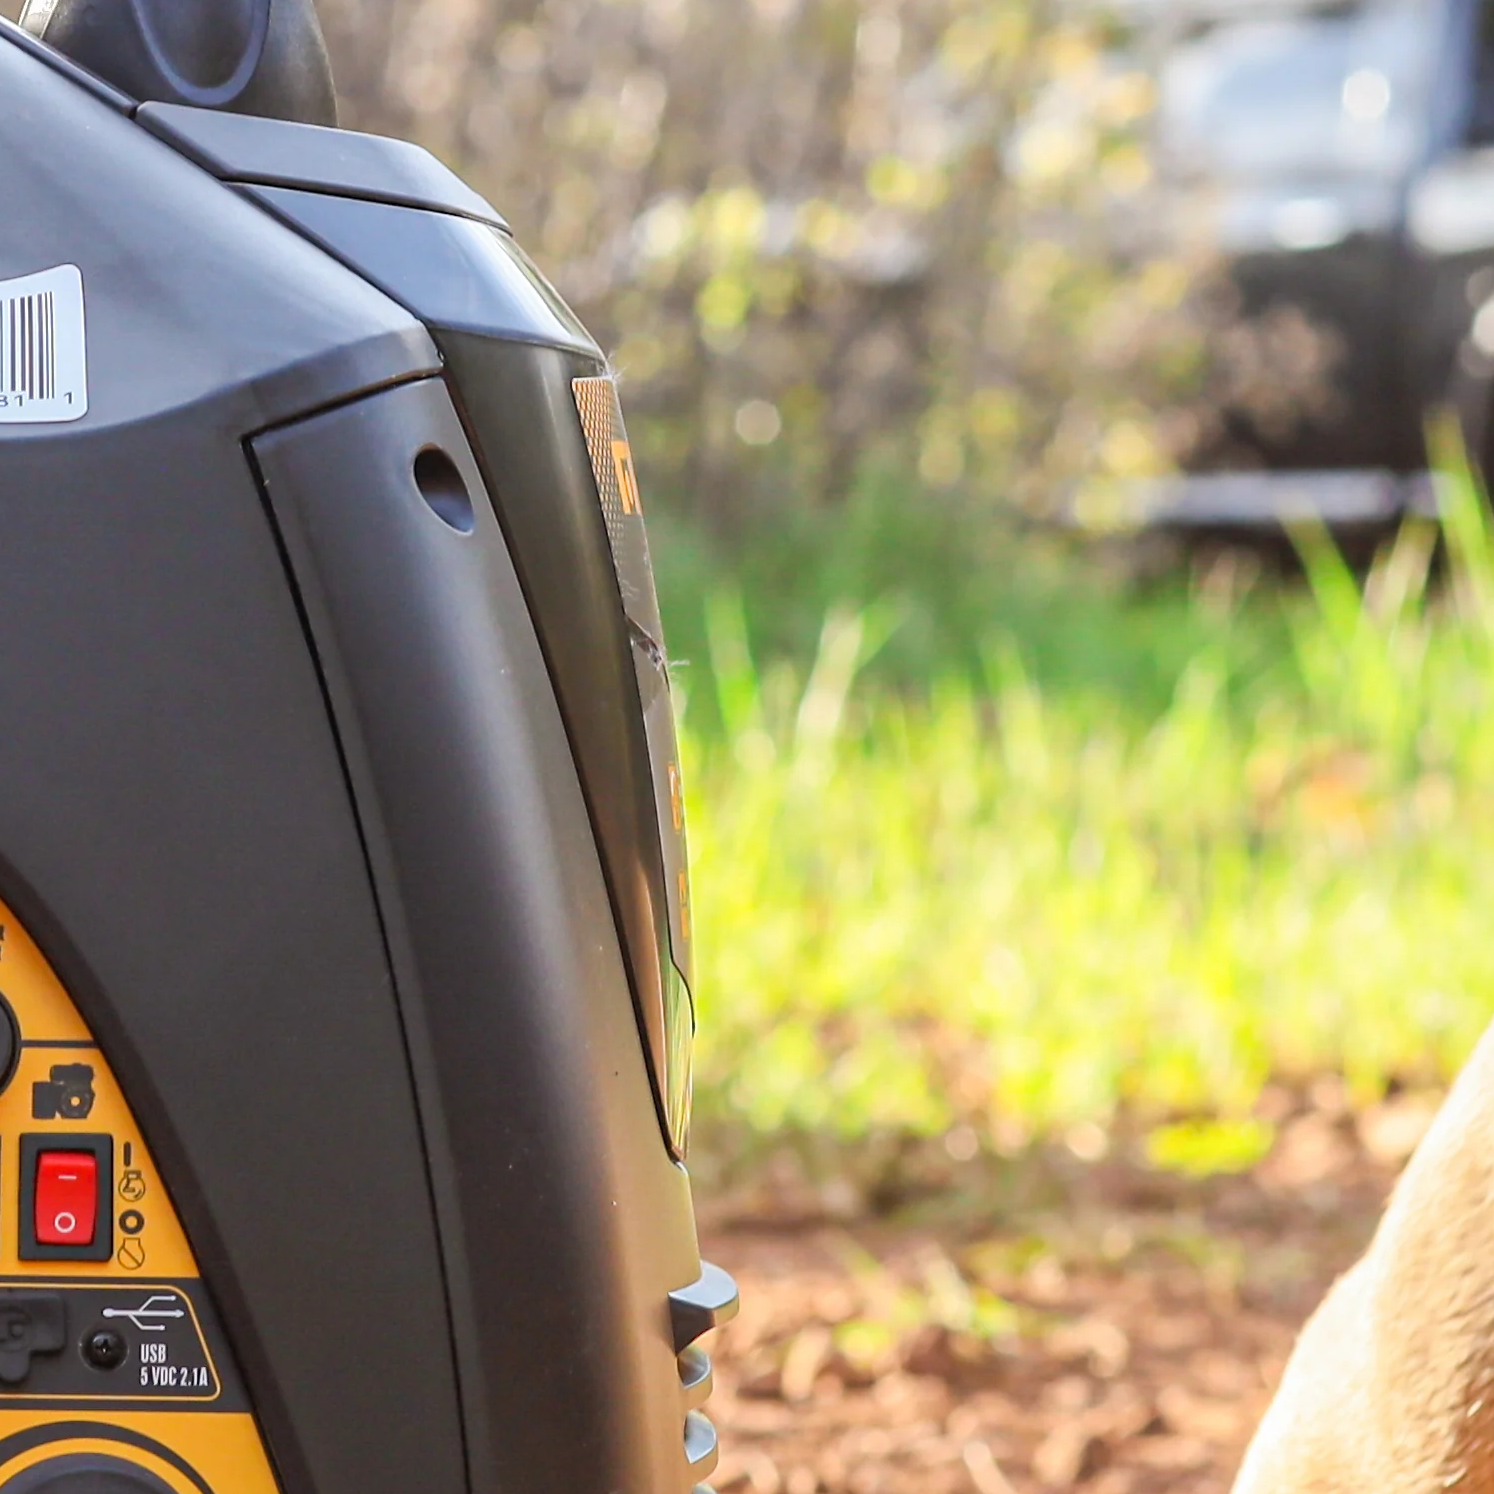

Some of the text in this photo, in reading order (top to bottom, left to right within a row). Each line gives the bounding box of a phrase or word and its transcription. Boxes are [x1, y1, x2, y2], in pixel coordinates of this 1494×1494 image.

[140, 1343, 167, 1364] USB
[140, 1366, 209, 1387] 5 VDC 2.1A
